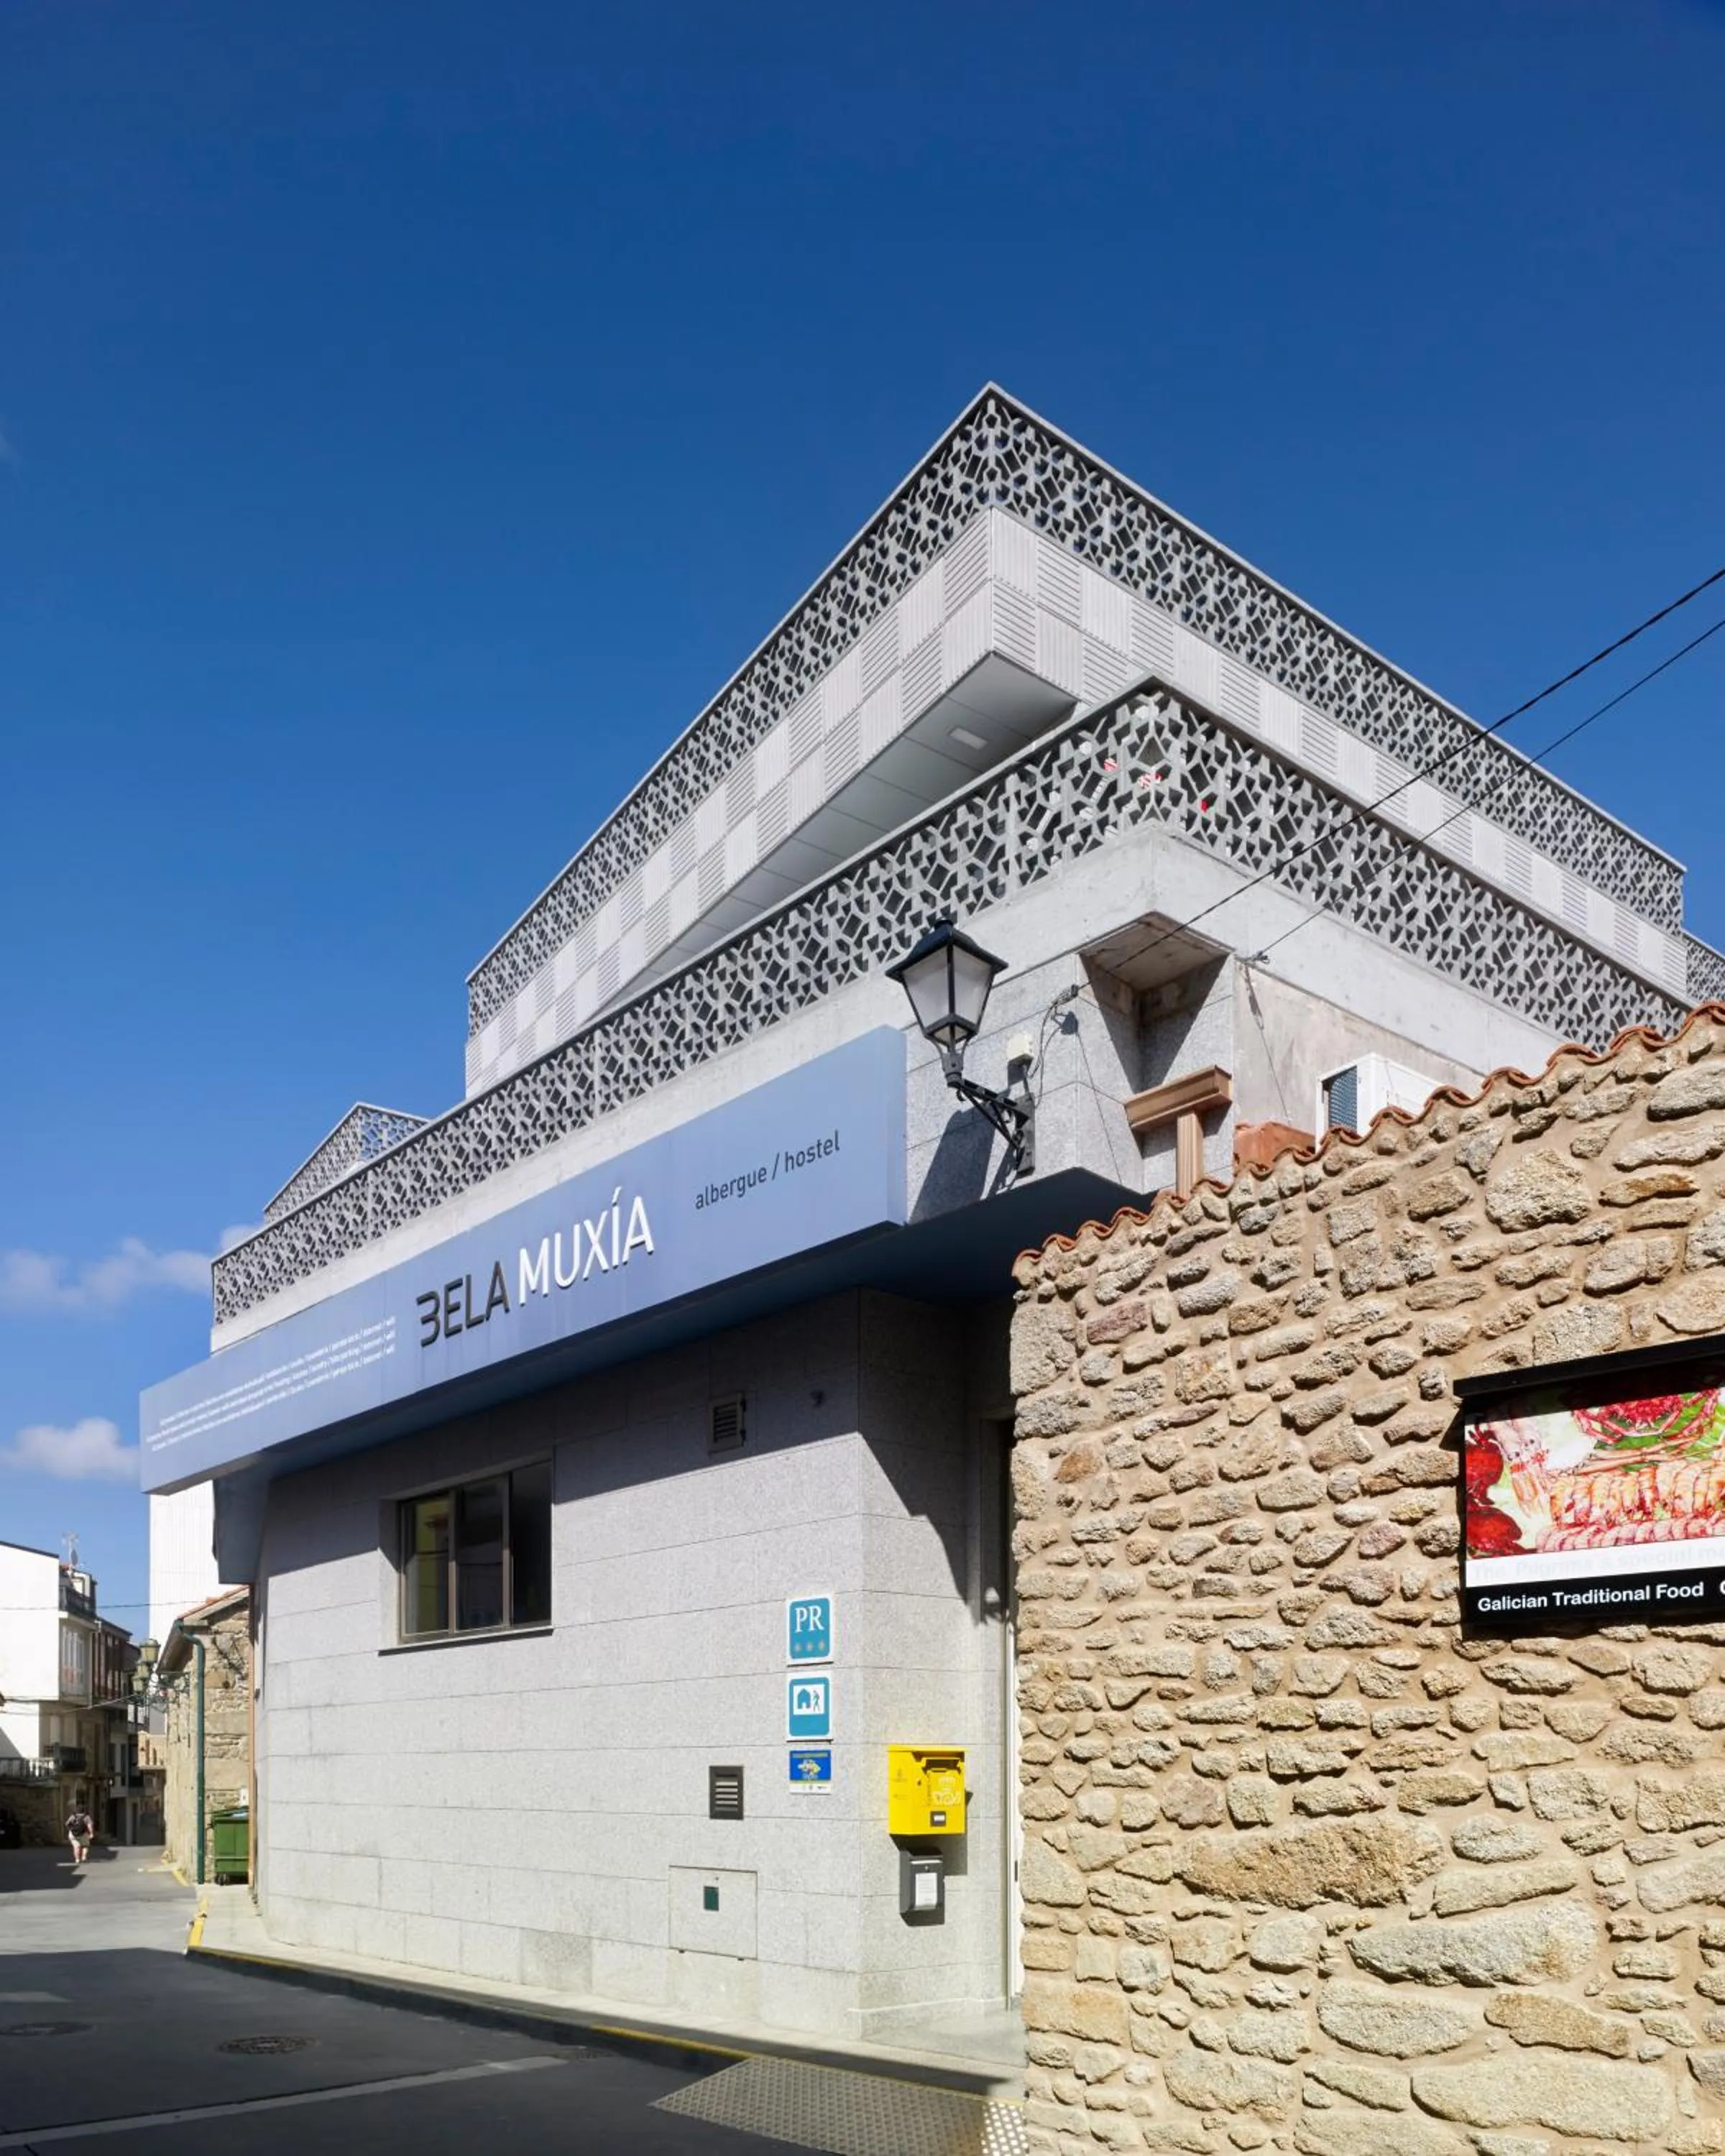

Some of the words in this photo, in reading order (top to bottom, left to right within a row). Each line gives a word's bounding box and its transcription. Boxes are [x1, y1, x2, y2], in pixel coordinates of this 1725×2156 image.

[695, 1167, 767, 1210] albergue
[784, 1130, 841, 1173] hostel
[518, 1186, 656, 1307] MUXÍA
[794, 1605, 824, 1634] PR
[1477, 1595, 1548, 1611] Galician
[1552, 1585, 1651, 1606] Traditional
[1655, 1582, 1704, 1599] Food
